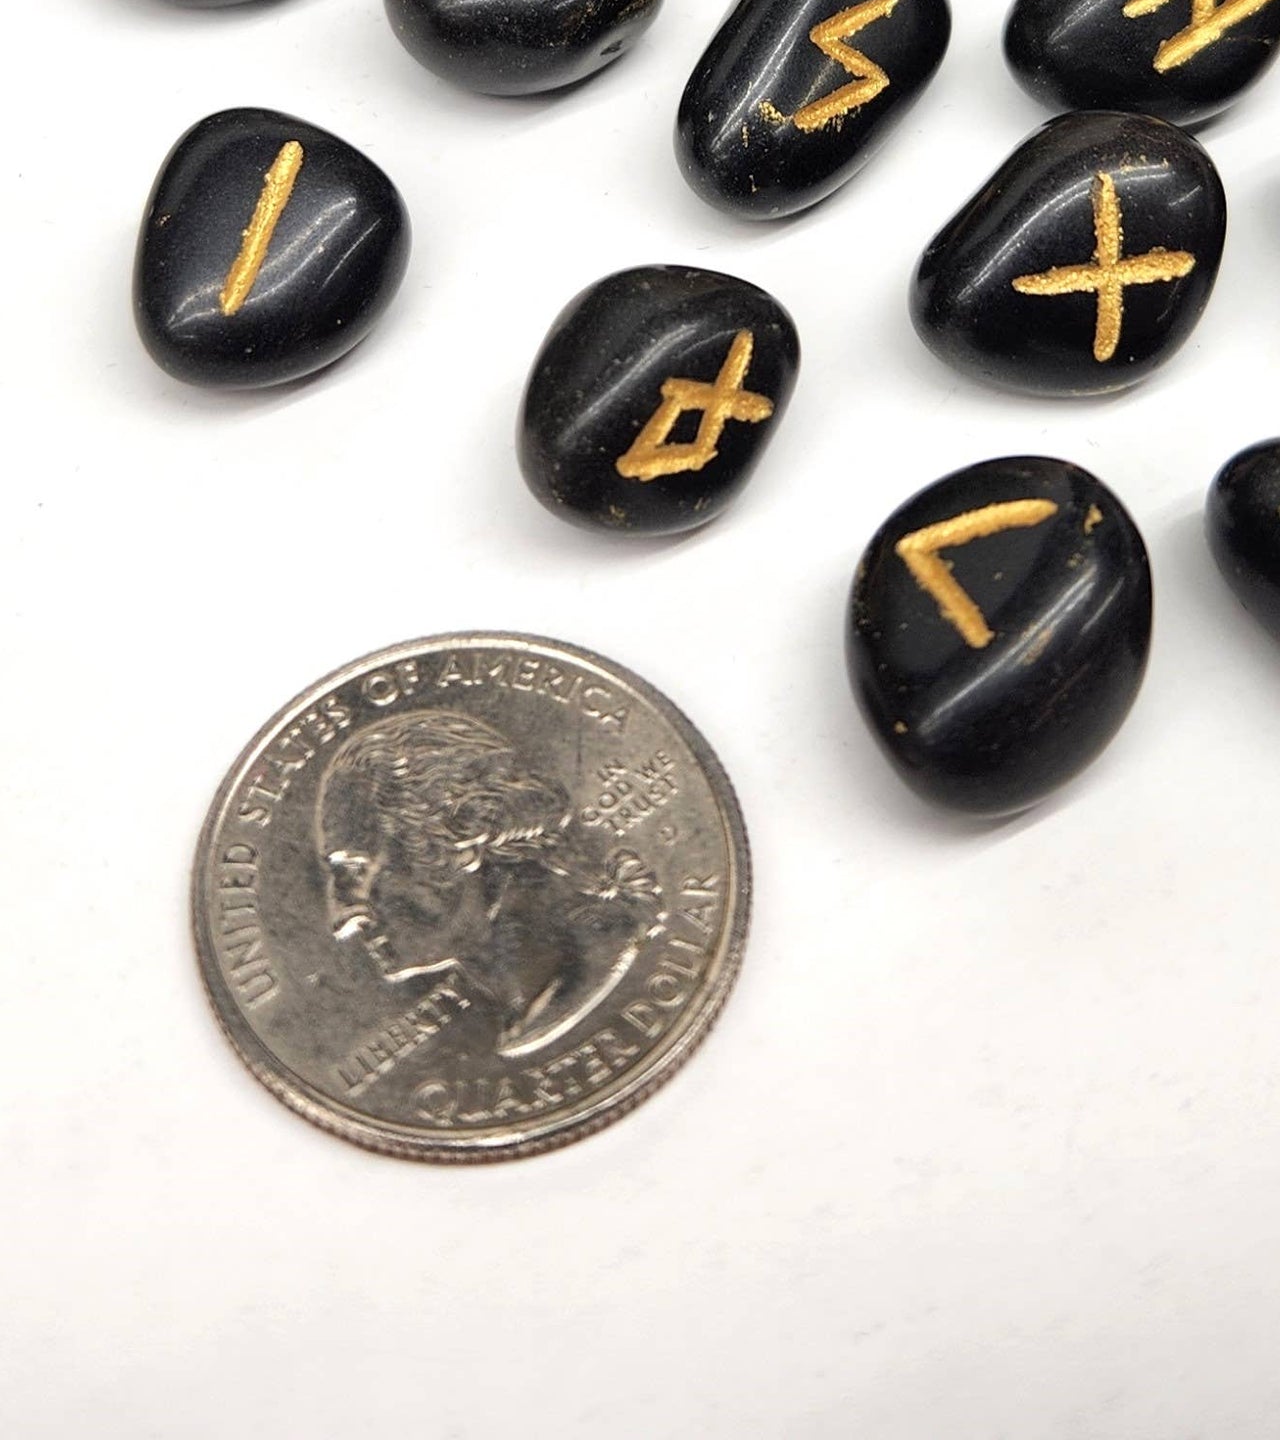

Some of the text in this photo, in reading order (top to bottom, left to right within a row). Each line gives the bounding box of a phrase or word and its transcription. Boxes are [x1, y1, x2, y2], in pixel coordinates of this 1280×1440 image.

[218, 654, 632, 1010] UNITED STATES OF AMERICA
[336, 972, 471, 1098] LIBERTY
[408, 873, 718, 1126] QUARTER DOLLAR
